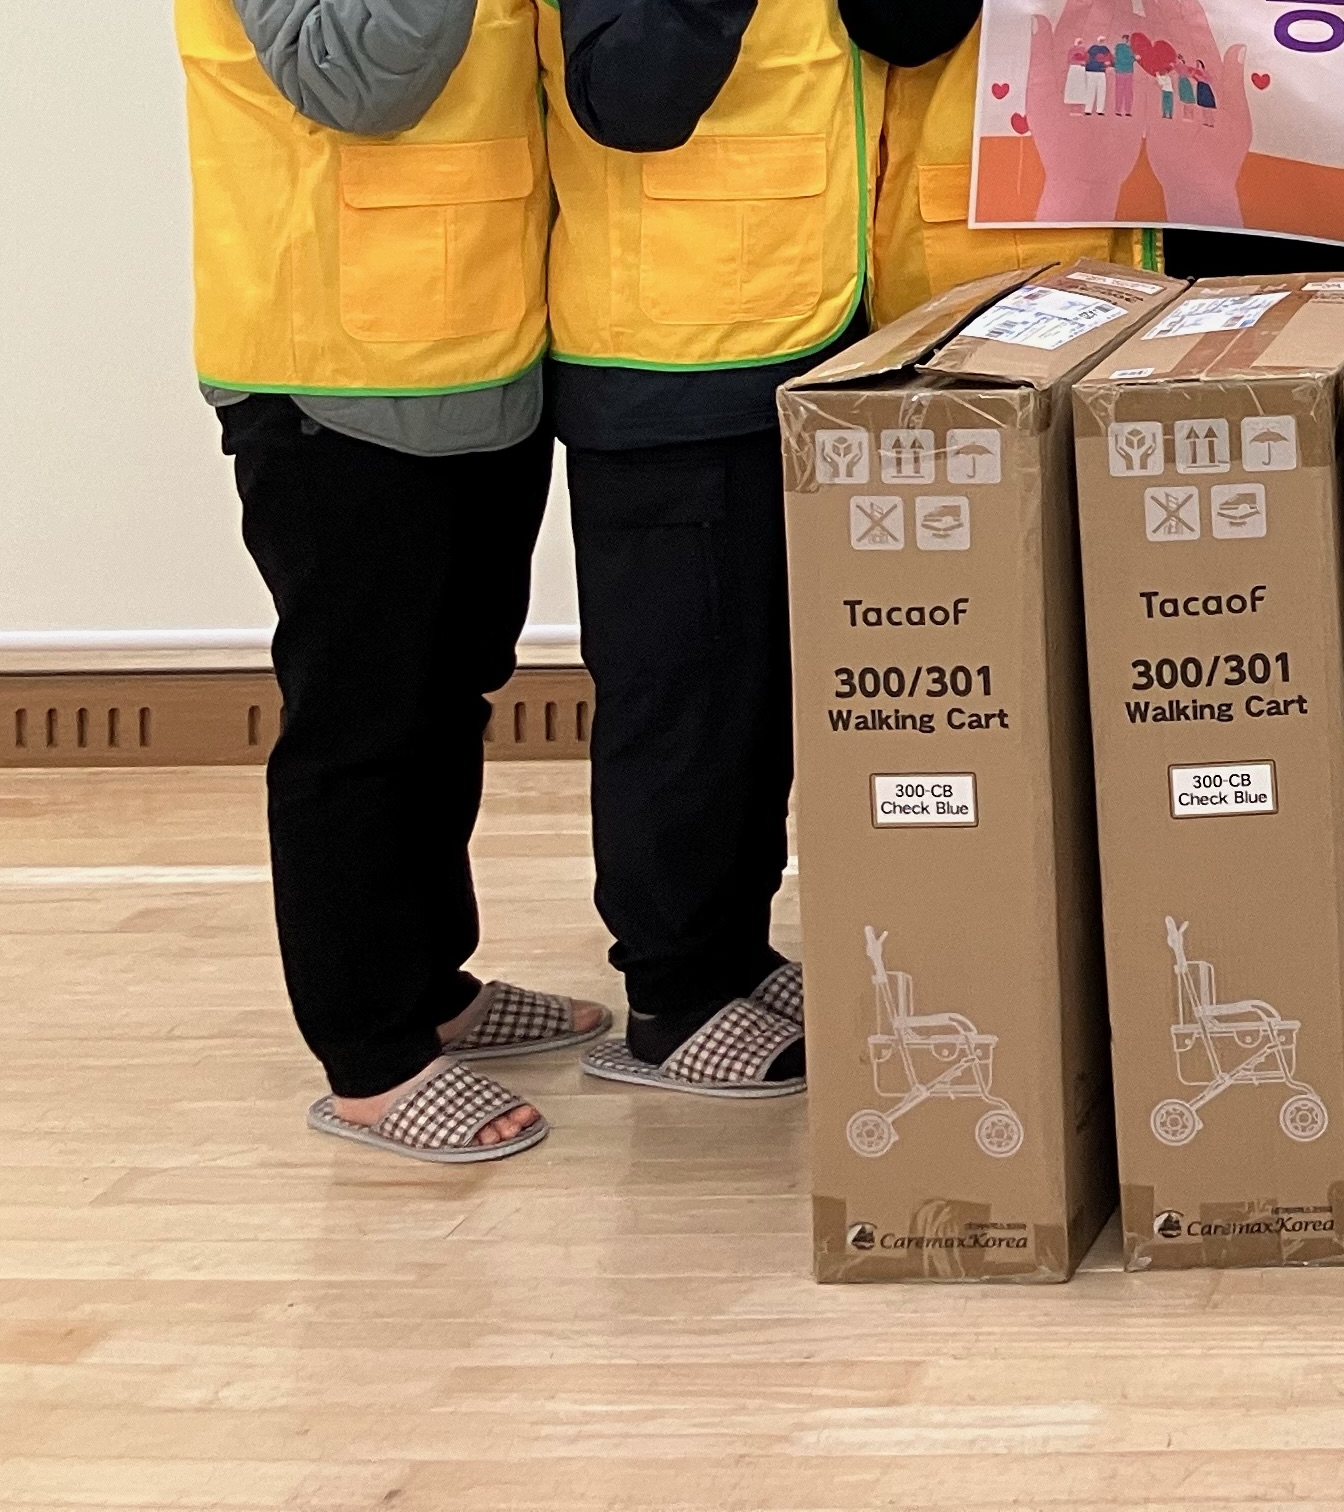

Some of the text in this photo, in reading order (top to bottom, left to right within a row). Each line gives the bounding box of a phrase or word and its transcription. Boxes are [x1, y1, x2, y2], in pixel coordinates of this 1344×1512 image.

[834, 665, 992, 699] 300/301
[1131, 651, 1290, 691] 300/301
[1124, 694, 1308, 724] Walking Cart
[827, 707, 1009, 734] Walking Cart
[895, 784, 953, 799] 300-CB
[1192, 773, 1252, 789] 300-CB
[880, 800, 968, 816] Check Blue
[1178, 789, 1268, 806] Check Blue
